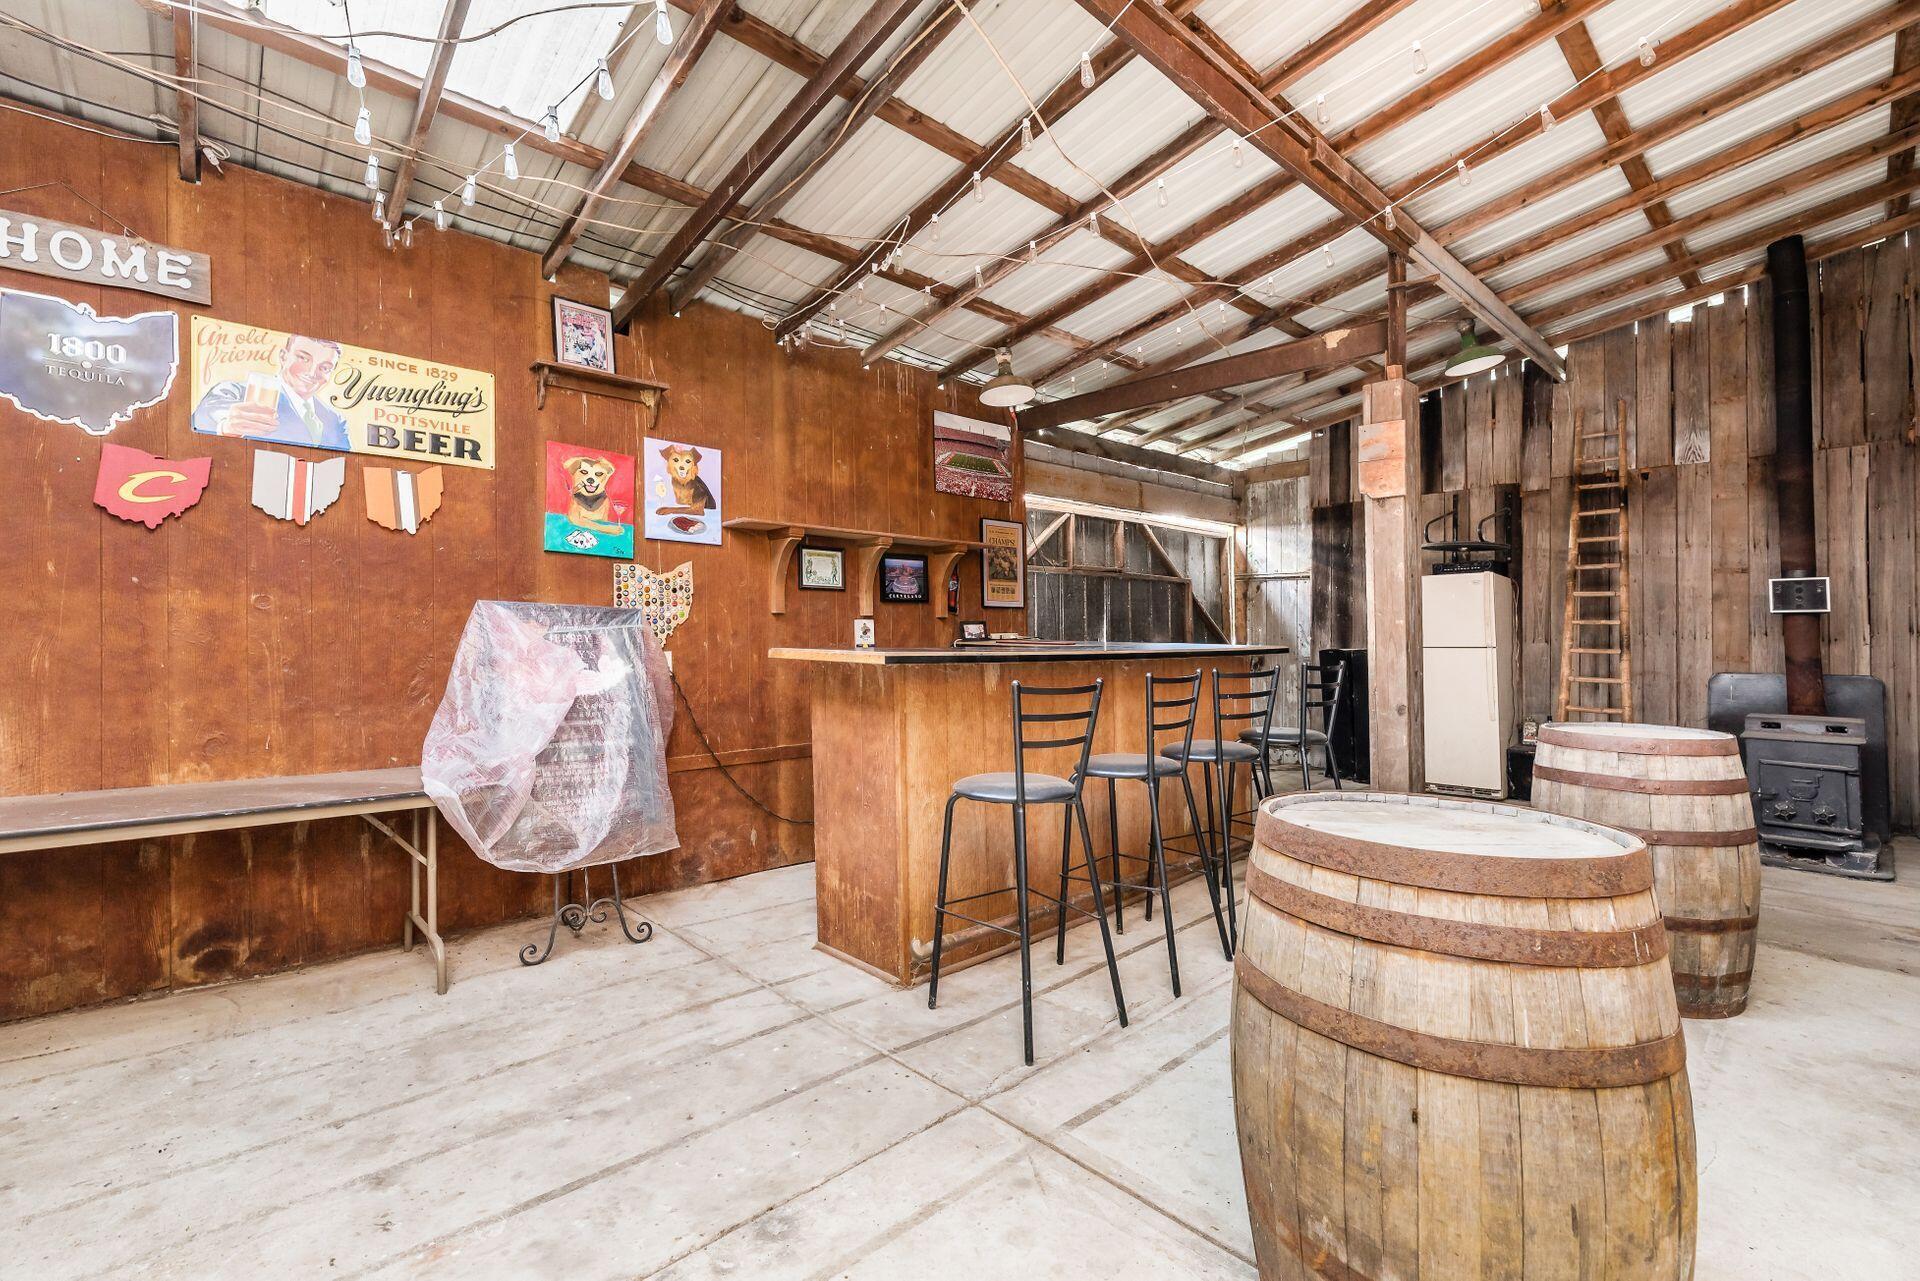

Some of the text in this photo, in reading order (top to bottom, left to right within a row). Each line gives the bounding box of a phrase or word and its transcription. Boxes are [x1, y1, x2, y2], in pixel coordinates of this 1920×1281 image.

[0, 217, 192, 289] HOME
[48, 333, 127, 364] 1800
[197, 323, 270, 346] An old
[45, 365, 126, 386] TEQUILA
[203, 345, 278, 385] friend
[368, 356, 458, 383] SINCE 1829
[330, 363, 488, 418] Yuengling's
[374, 407, 471, 435] POTTSVILLE
[367, 423, 483, 461] BEER
